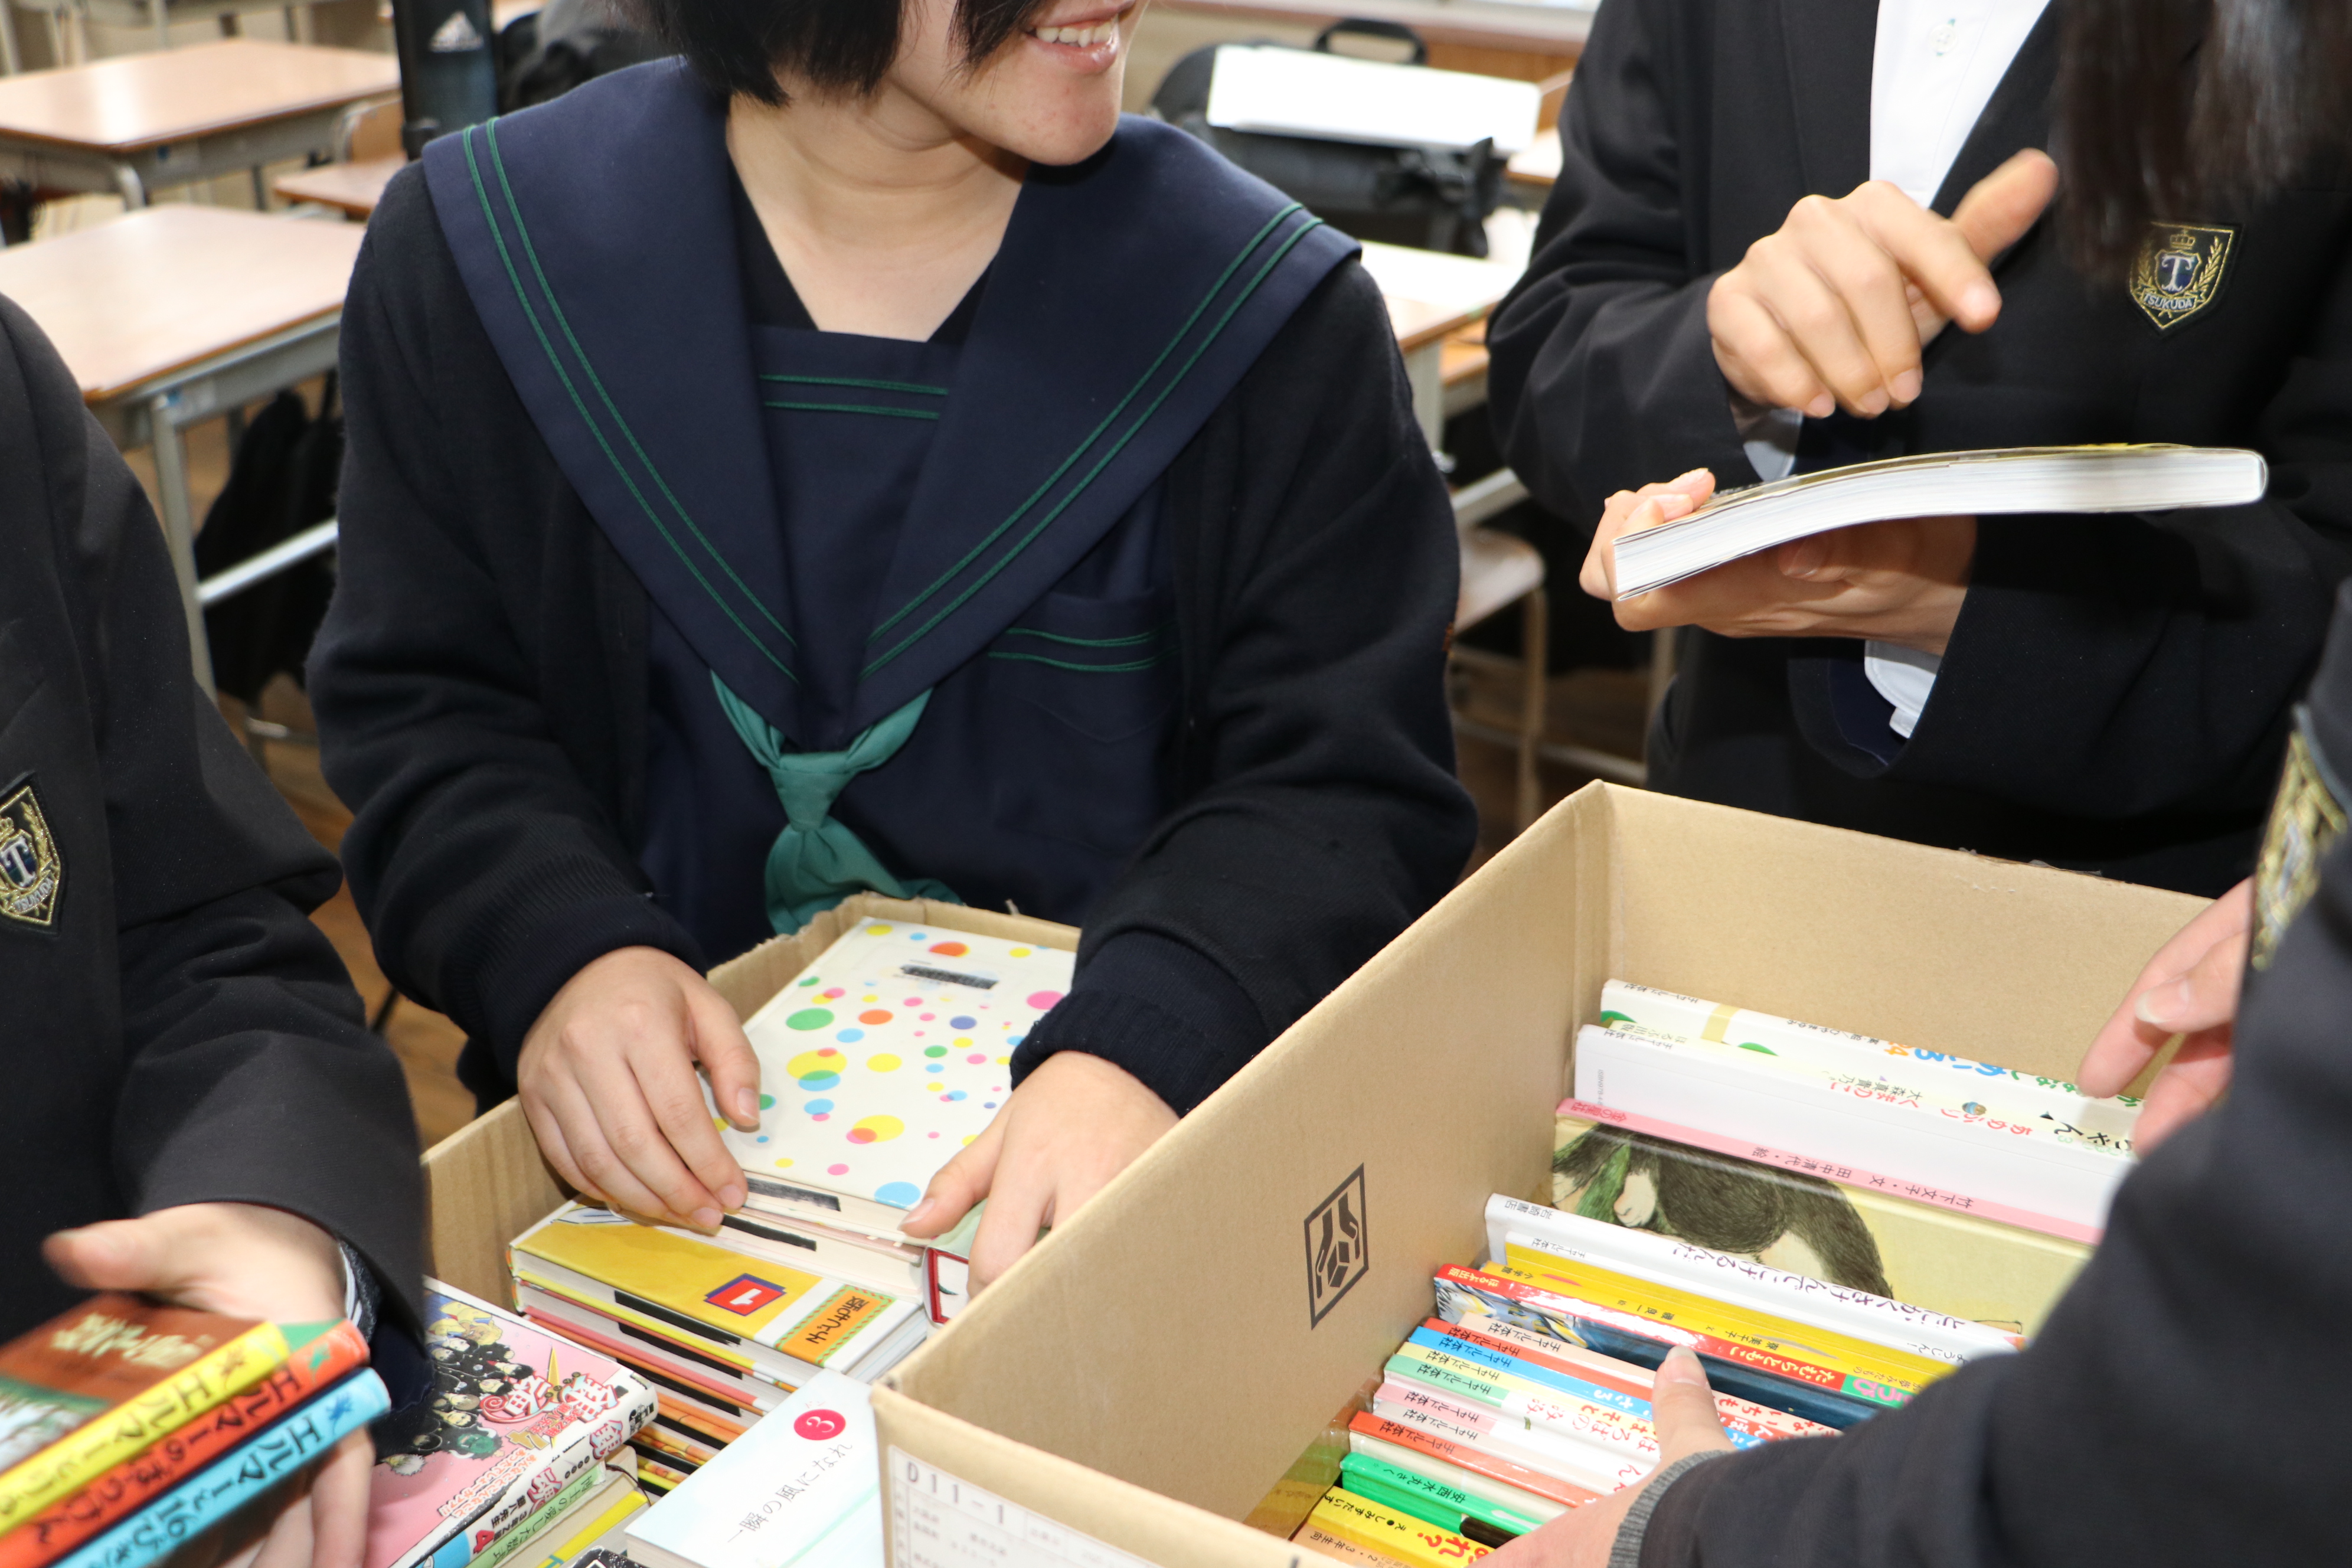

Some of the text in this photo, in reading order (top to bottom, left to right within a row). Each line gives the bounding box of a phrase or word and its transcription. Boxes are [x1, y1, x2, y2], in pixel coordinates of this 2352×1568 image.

[2161, 254, 2195, 292] T
[2144, 293, 2194, 310] TSUKUDA
[1, 835, 36, 887] T
[1883, 1040, 1910, 1058] 24
[1842, 1074, 1923, 1100] 大森真貴乃
[1573, 1101, 1627, 1121] 金の星社
[1830, 1080, 2033, 1135] あめふり くまのこ
[1752, 1146, 1974, 1209] 竹下文子・文 田中清代・絵
[1505, 1200, 1552, 1219] 岩崎書店
[1532, 1239, 1585, 1257] チャイルド本社
[1448, 1266, 1500, 1287] ほるぷ出版
[1500, 1265, 1533, 1279] 小学館
[1671, 1242, 1965, 1329] とにかくさけんでにげるんだ
[806, 1296, 870, 1345] 子ども版
[1439, 1337, 1512, 1368] チャイルド本社
[1449, 1327, 1520, 1357] チャイルド本社
[1488, 1322, 1561, 1353] チャイルド本社
[1417, 1363, 1491, 1395] チャイルド本社
[1426, 1350, 1500, 1381] チャイルド本社
[1730, 1345, 1836, 1383] たむらともこ
[1405, 1390, 1479, 1423] チャイルド本社
[1581, 1404, 1621, 1422] そと
[1713, 1395, 1782, 1425] いちも
[806, 1414, 835, 1435] 3
[1380, 1420, 1455, 1454] チャイルド本社
[1403, 1408, 1478, 1440] チャイルド本社
[1573, 1413, 1631, 1440] ろばの
[727, 1442, 852, 1543] 一瞬の風になれ
[474, 1529, 495, 1553] 4
